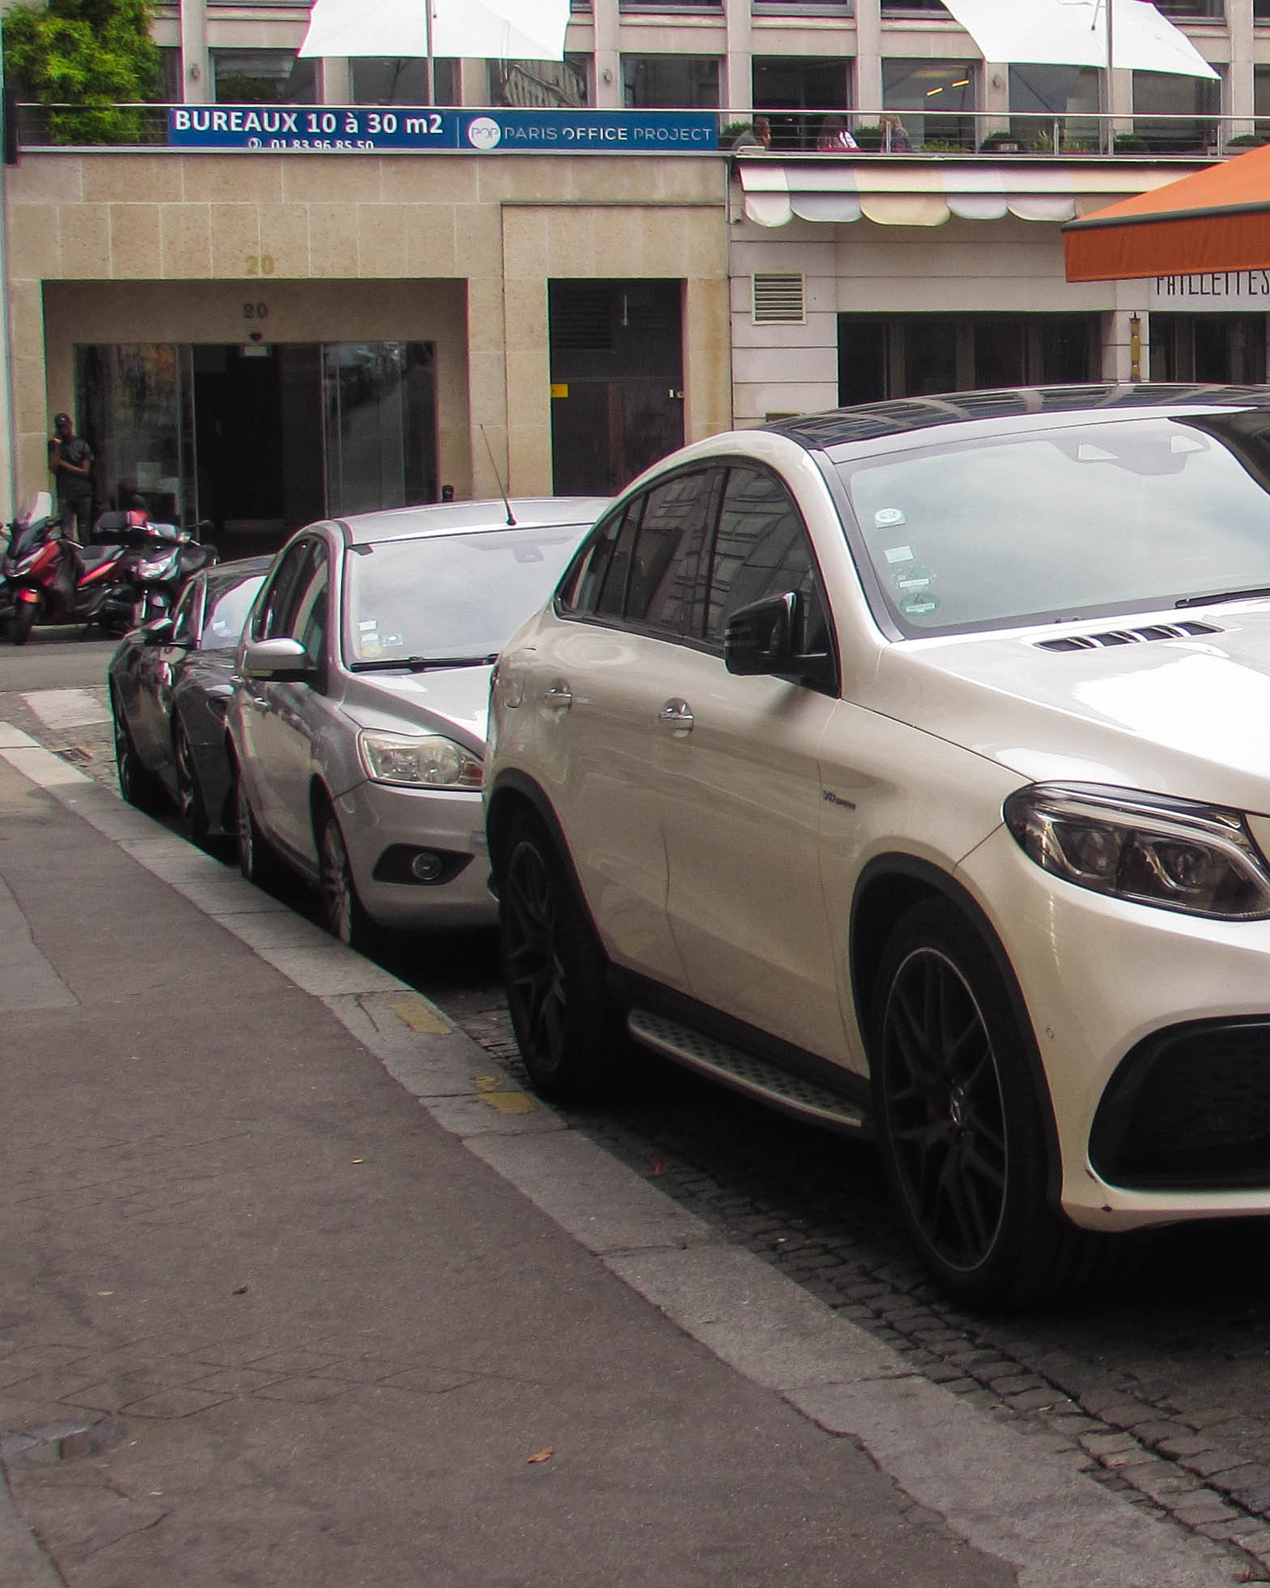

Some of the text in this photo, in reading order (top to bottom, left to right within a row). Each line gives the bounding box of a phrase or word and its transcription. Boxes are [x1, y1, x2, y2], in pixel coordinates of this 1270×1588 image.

[175, 111, 443, 134] BUREAUX 10 à 30 m2
[505, 127, 712, 141] PARIS OFFICE PROJECT
[245, 254, 275, 275] 20
[243, 302, 268, 318] 20
